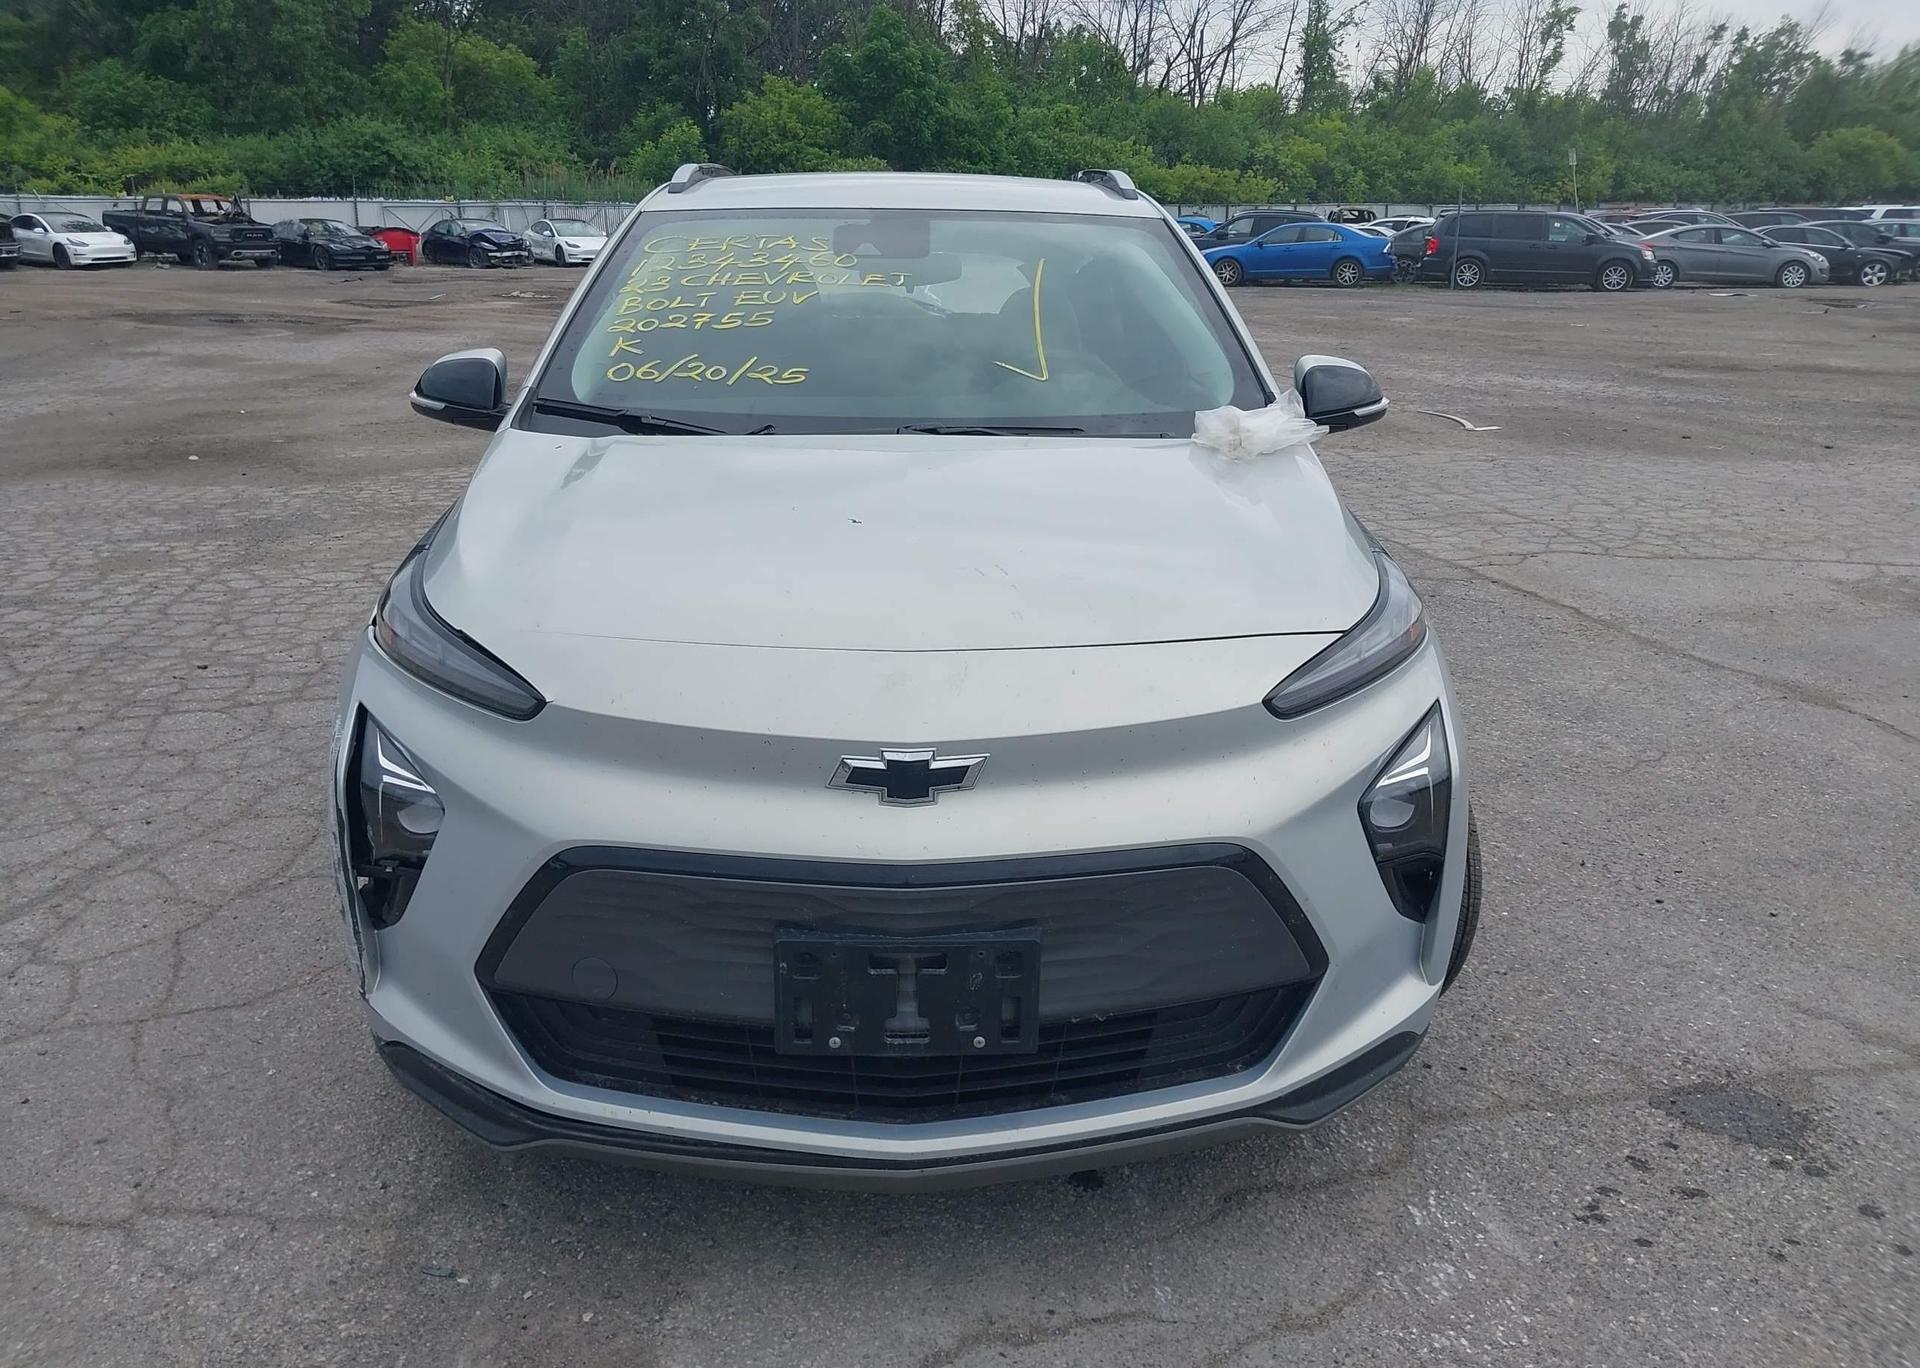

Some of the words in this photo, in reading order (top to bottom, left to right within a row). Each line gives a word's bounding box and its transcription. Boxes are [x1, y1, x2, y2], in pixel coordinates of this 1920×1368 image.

[644, 234, 830, 253] CERTAS
[680, 271, 913, 287] CHEVROLET
[616, 291, 718, 316] BOLT
[733, 289, 820, 306] EUV
[607, 310, 776, 333] 202755
[607, 336, 645, 358] K
[606, 353, 810, 386] 06/20/25
